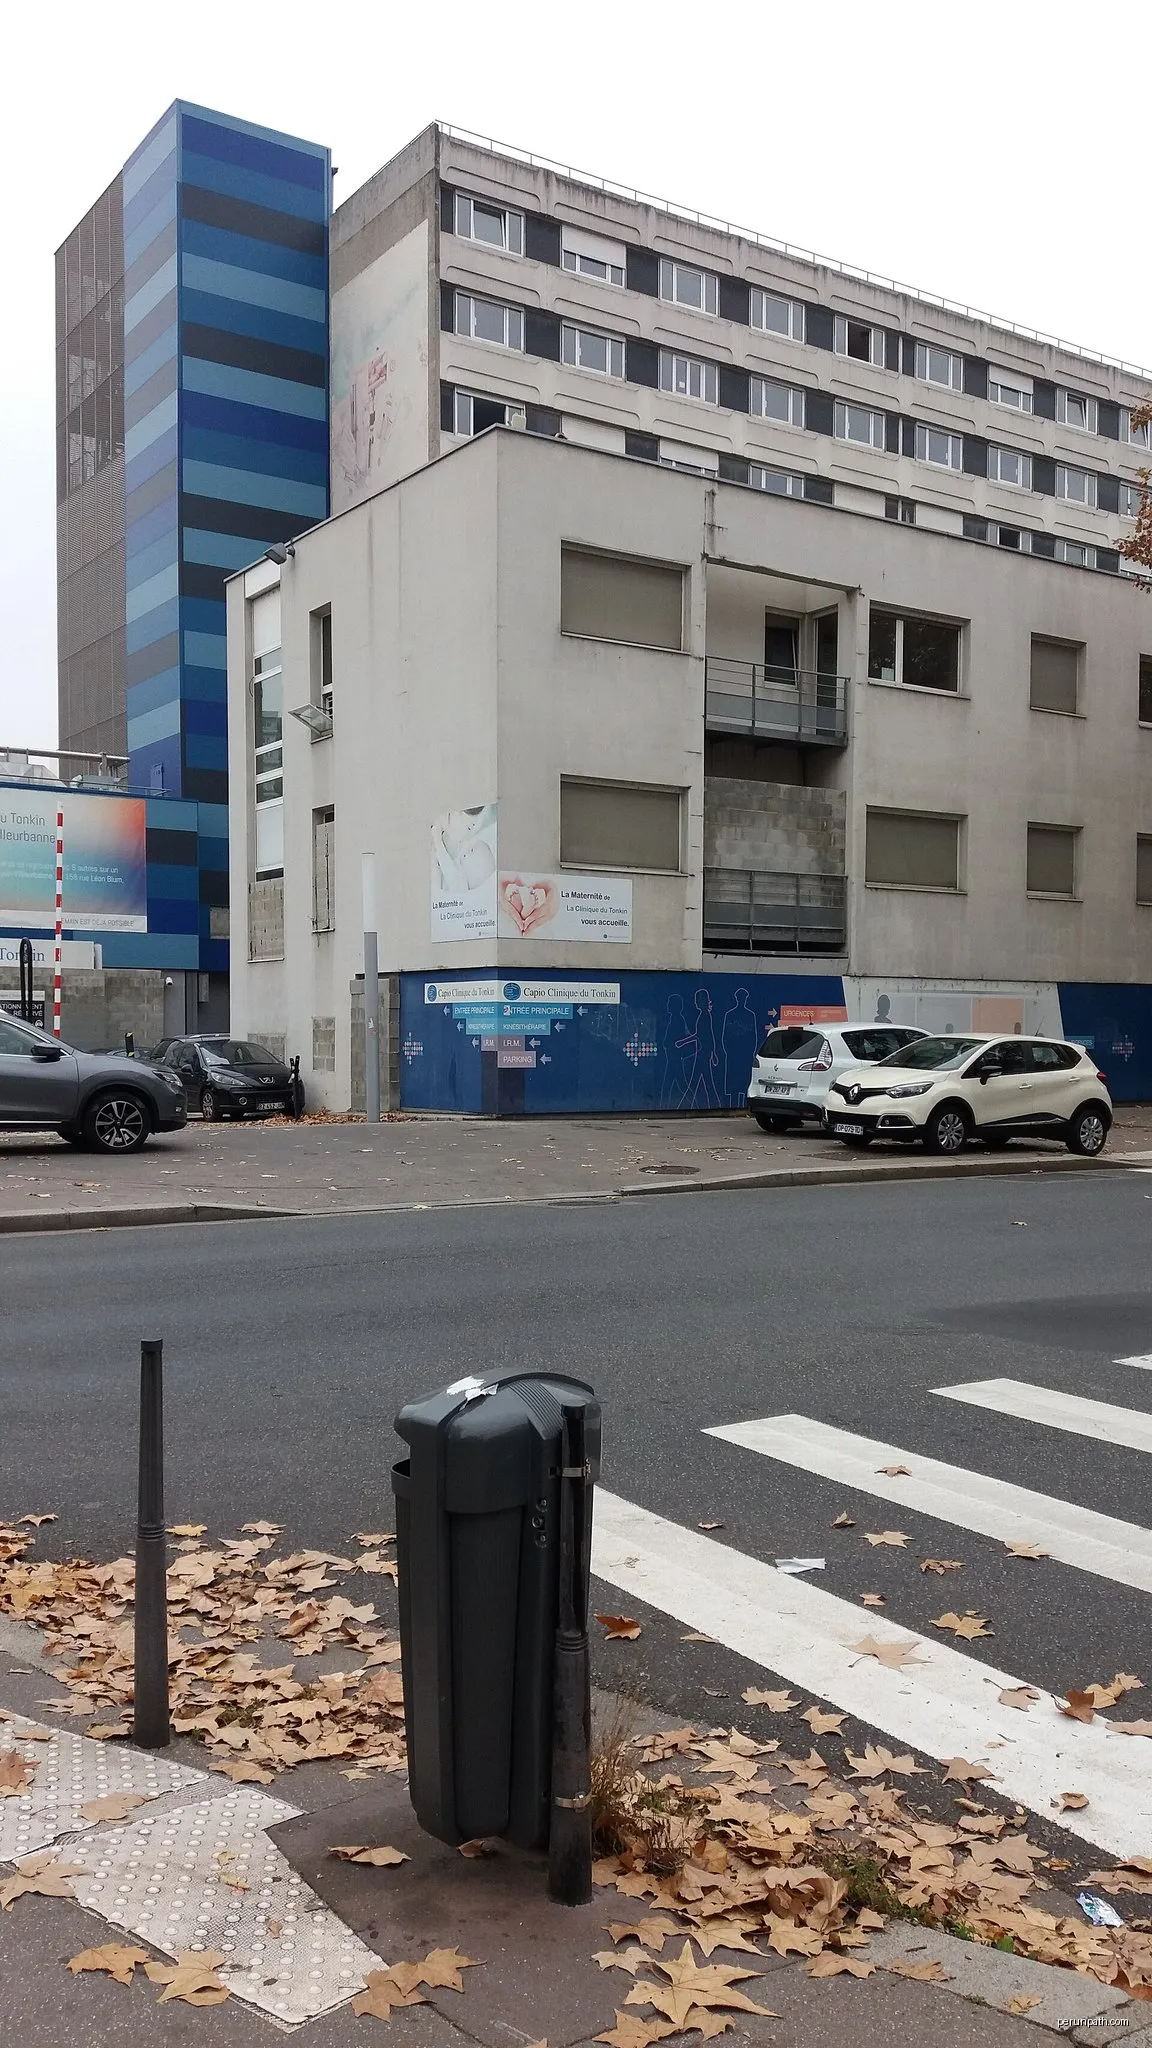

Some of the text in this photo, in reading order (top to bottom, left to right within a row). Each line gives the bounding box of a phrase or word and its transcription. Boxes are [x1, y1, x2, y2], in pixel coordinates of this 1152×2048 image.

[11, 812, 45, 827] Tonkin
[78, 865, 98, 873] autres
[79, 874, 89, 882] rue
[91, 874, 105, 882] Léon
[560, 890, 570, 898] La
[571, 891, 603, 900] Maternité
[566, 904, 575, 912] La
[575, 905, 600, 913] Clinique
[580, 918, 630, 927] vous accueille.
[0, 947, 46, 961] Toin
[523, 987, 616, 999] Capio Clinique du Tonkin
[504, 1005, 570, 1015] NTRÉE PRINCIPALE
[503, 1055, 533, 1063] PARKING
